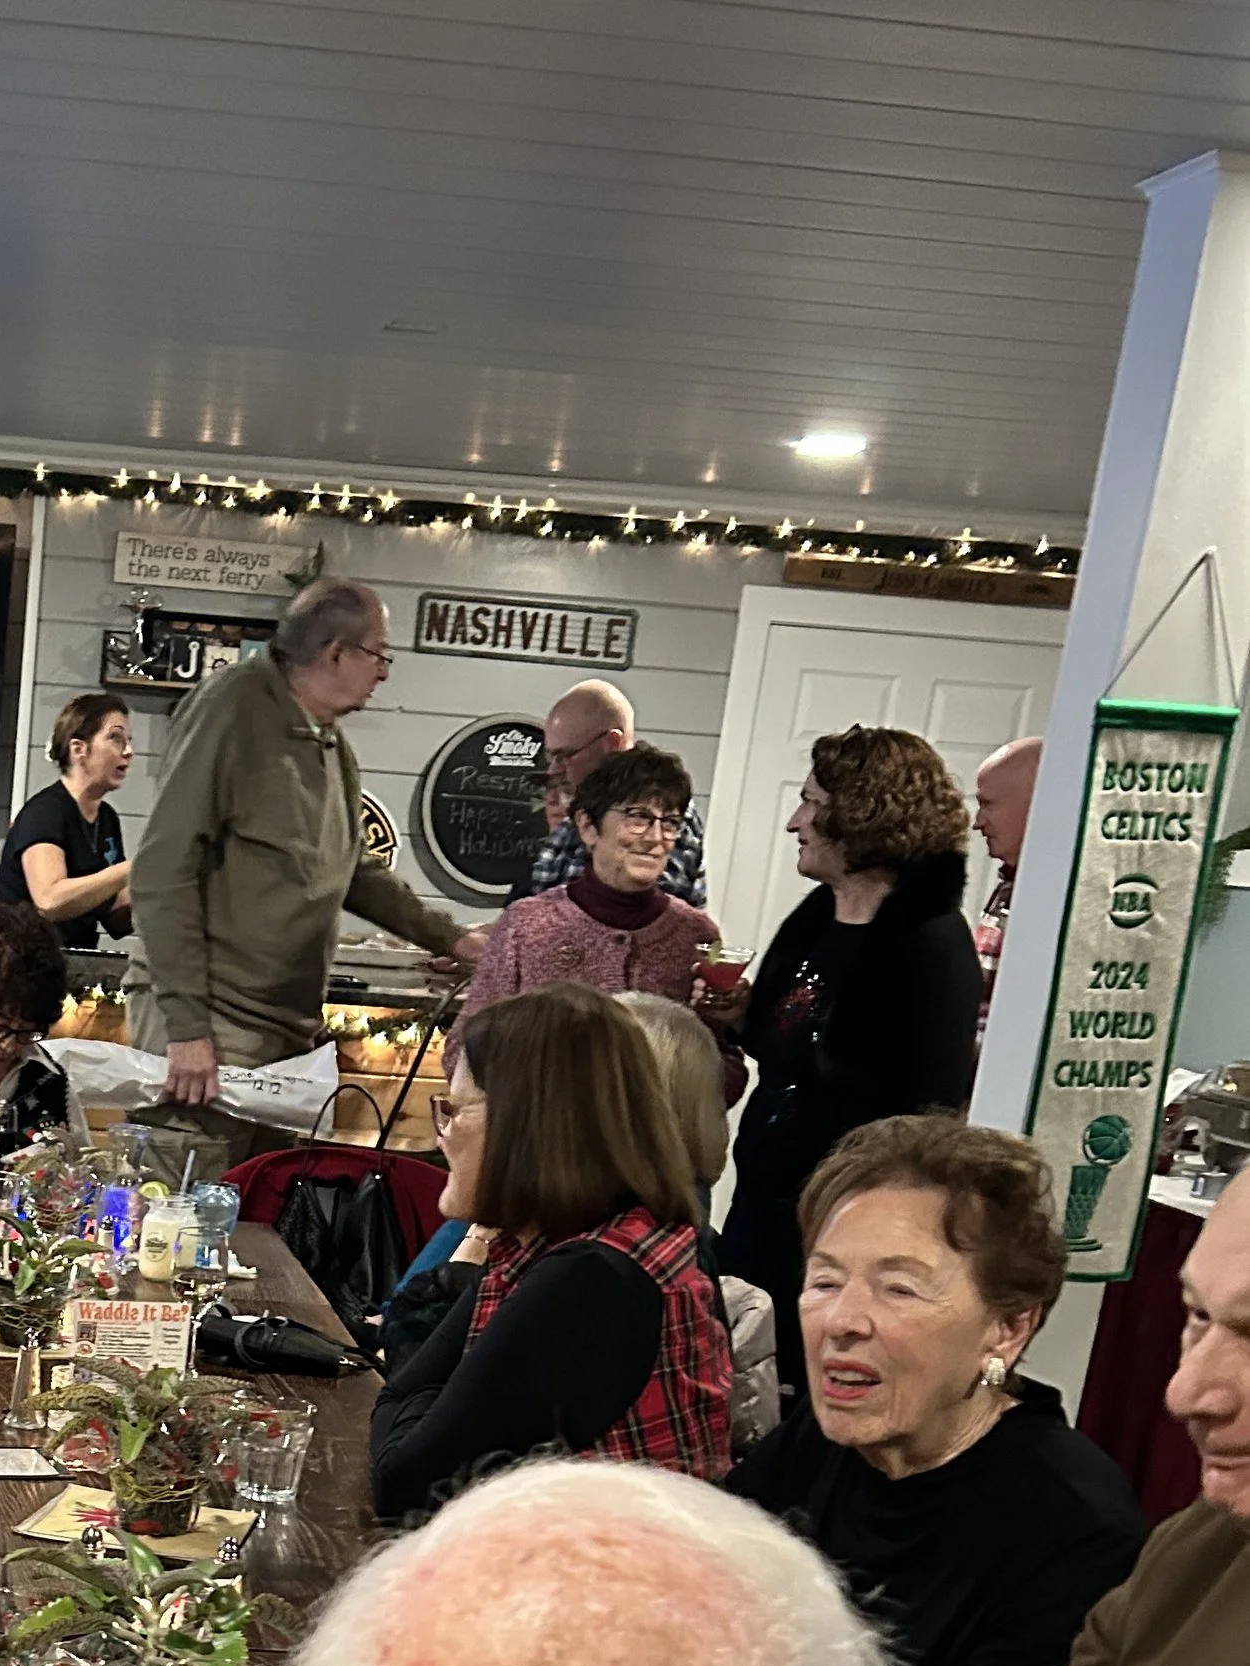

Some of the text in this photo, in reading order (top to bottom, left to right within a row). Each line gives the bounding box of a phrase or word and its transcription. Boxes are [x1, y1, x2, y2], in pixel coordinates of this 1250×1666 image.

[127, 537, 271, 570] There's always
[128, 560, 266, 590] the next ferry
[425, 602, 627, 658] NASHVILLE
[484, 732, 542, 759] Smoky
[1102, 760, 1209, 793] BOSTON
[1101, 809, 1192, 842] CELTICS
[1112, 891, 1150, 913] NBA
[1090, 960, 1150, 990] 2024
[1068, 1010, 1156, 1040] WORLD
[1054, 1059, 1153, 1088] CHAMPS
[79, 1302, 190, 1323] Waddle It Be?
